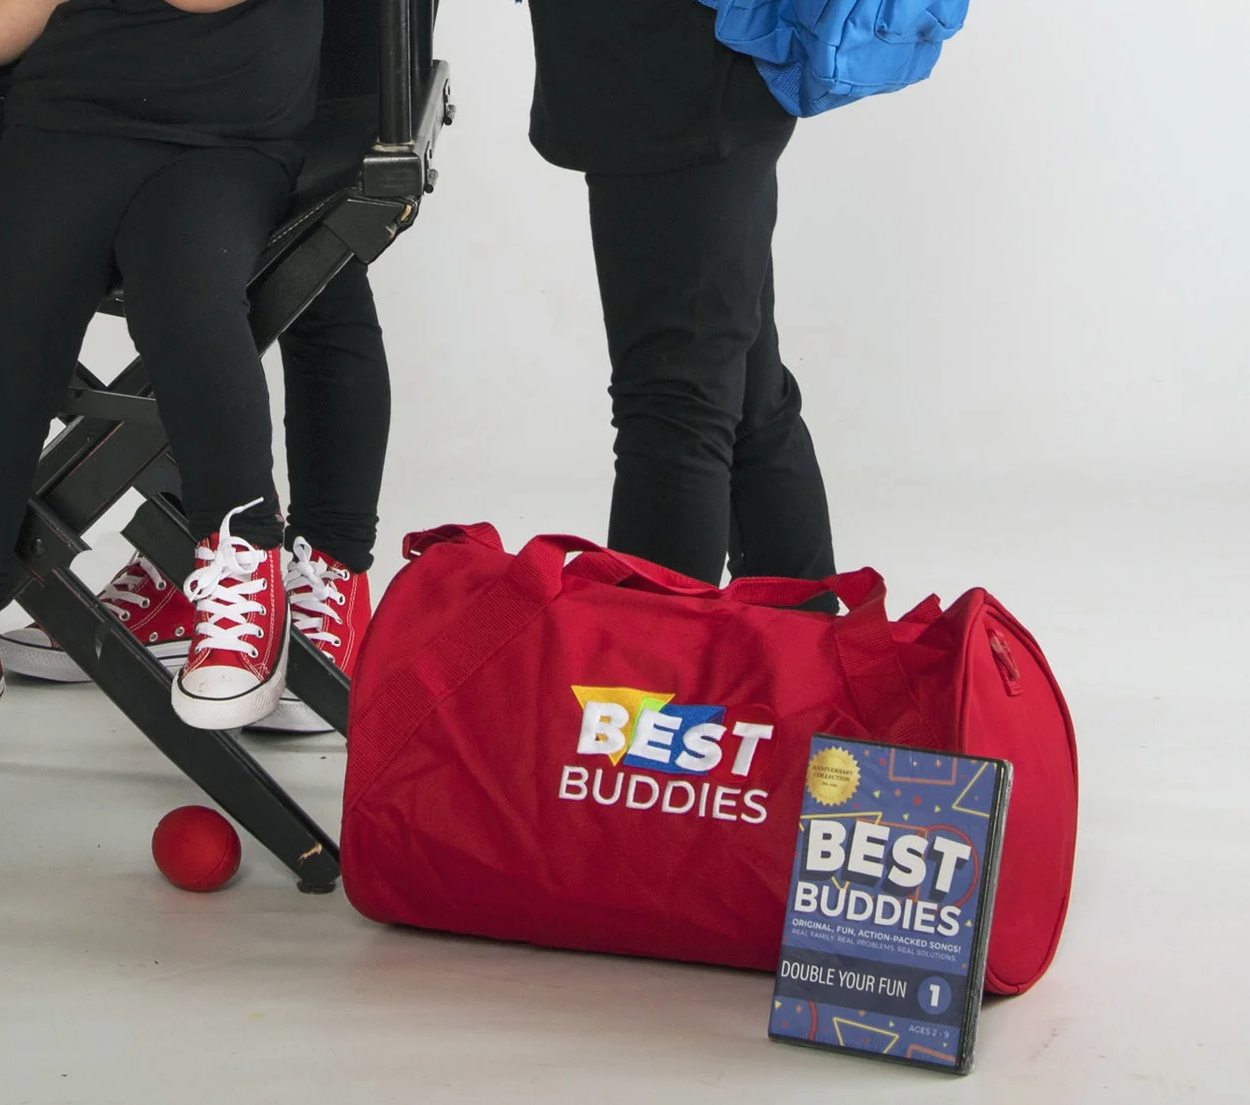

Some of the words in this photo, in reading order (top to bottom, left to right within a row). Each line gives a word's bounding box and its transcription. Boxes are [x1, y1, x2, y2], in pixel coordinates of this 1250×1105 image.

[576, 701, 774, 777] BEST
[558, 764, 768, 824] BUDDIES
[805, 819, 972, 895] BEST
[794, 880, 962, 937] BUDDIES
[792, 918, 835, 933] ORIGINAL,
[836, 925, 856, 936] FUN,
[858, 929, 927, 948] ACTION-PACKED
[929, 941, 962, 954] SONGS!
[781, 960, 835, 986] DOUBLE
[838, 970, 875, 993] YOUR
[878, 977, 907, 998] FUN
[930, 983, 941, 1007] 1
[909, 1025, 931, 1036] AGES
